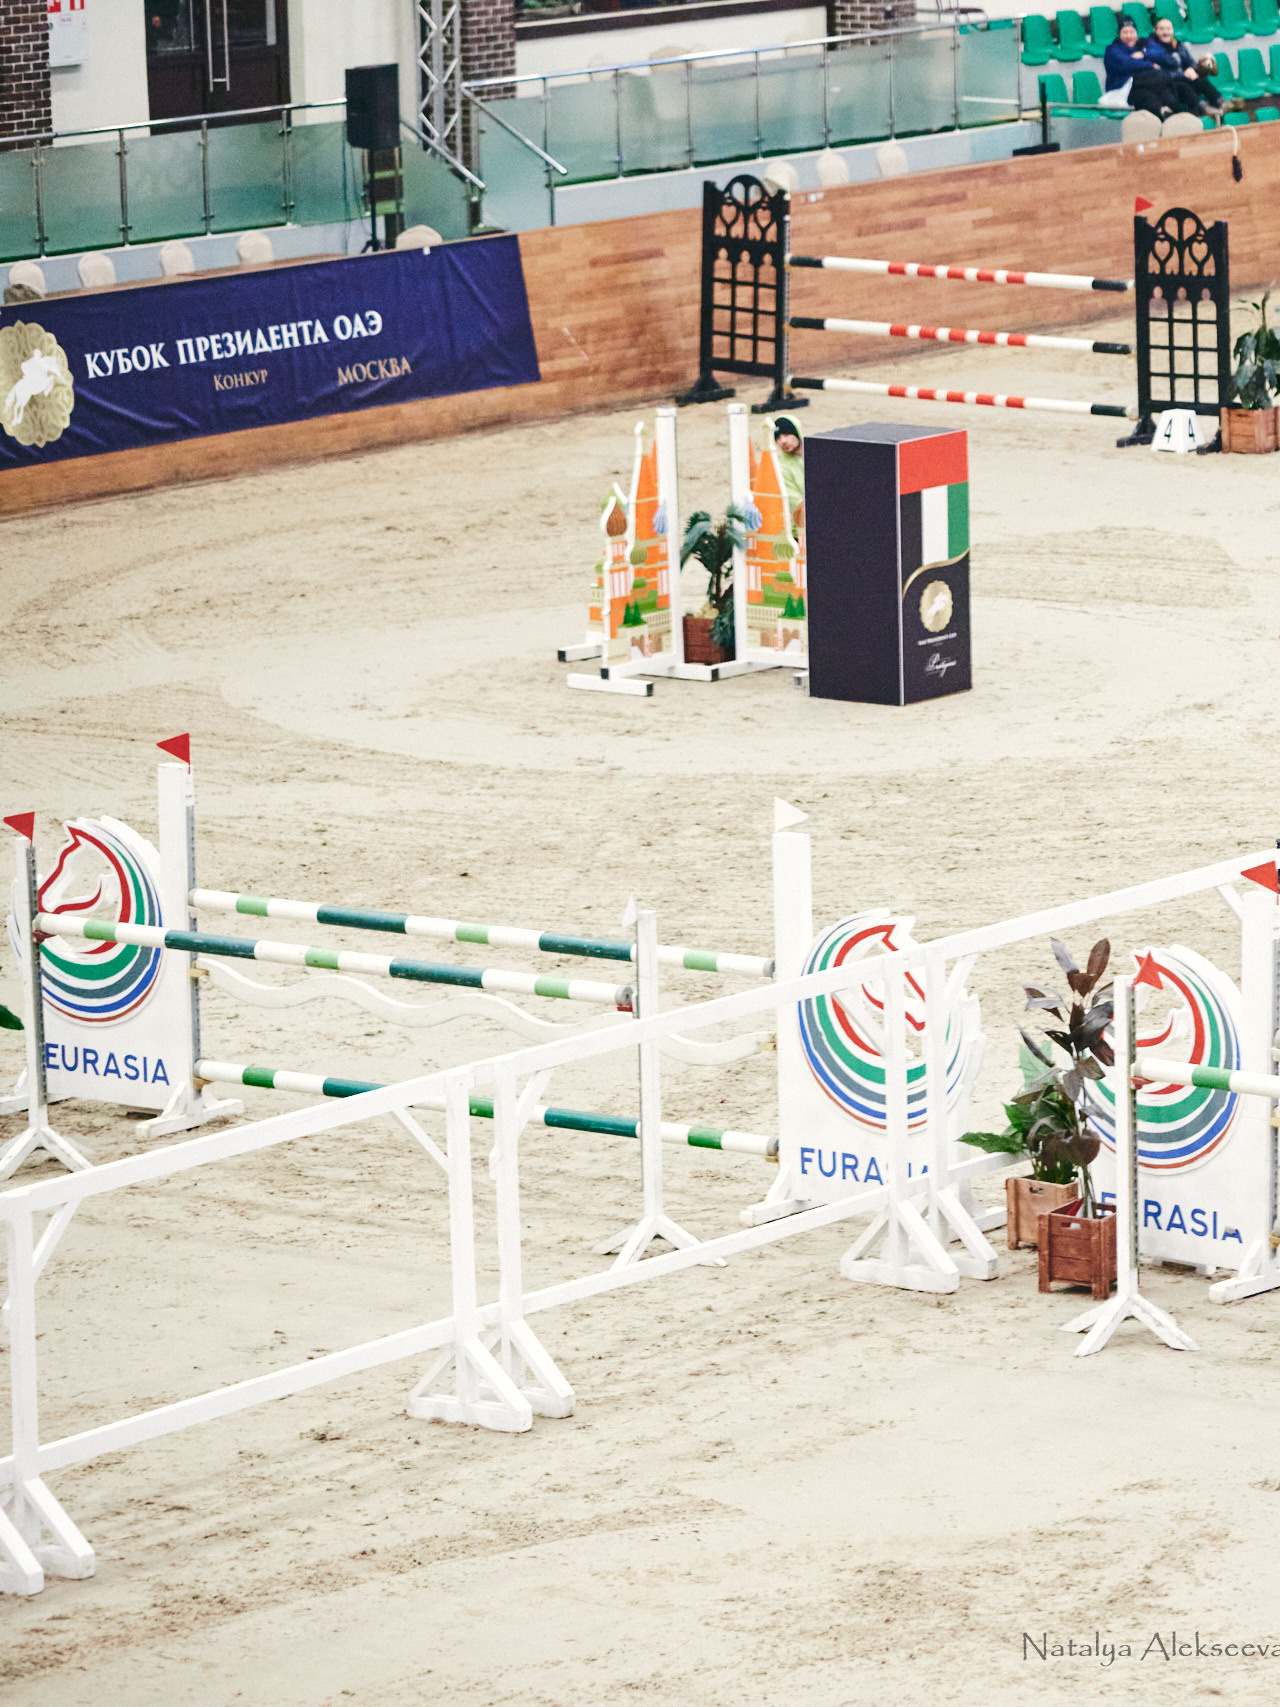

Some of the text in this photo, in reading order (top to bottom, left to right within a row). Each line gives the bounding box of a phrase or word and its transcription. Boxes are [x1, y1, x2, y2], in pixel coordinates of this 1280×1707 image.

[84, 310, 383, 379] КУБОК ПРЕЗИДЕНТА ОАЭ
[337, 356, 412, 387] МОСКВА
[1163, 418, 1173, 443] 4
[1188, 417, 1196, 443] 4
[44, 1042, 170, 1086] EURASIA
